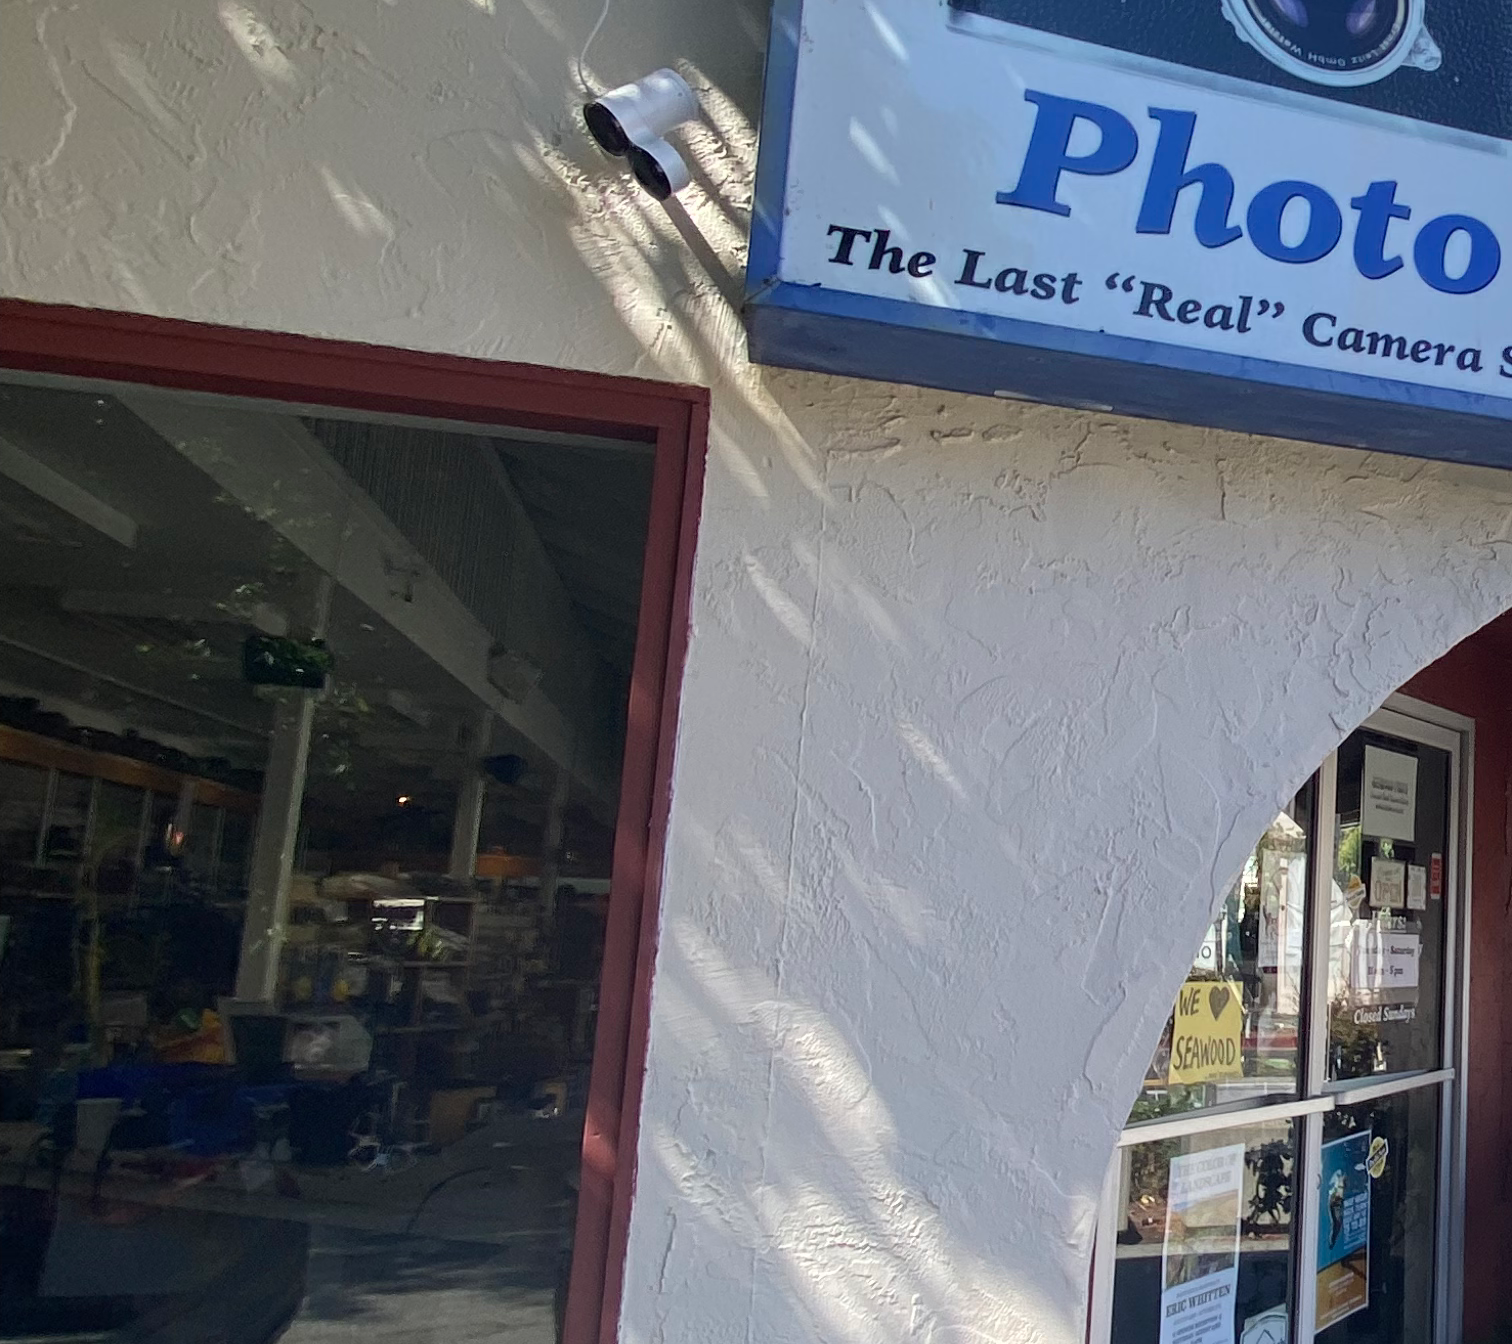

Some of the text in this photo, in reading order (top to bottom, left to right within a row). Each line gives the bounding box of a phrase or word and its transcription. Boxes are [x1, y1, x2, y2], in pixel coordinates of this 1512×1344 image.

[996, 88, 1501, 295] Photo
[825, 223, 936, 279] The
[955, 248, 1083, 305] Last
[1105, 271, 1285, 334] “Real”
[1302, 312, 1484, 374] Camera
[1179, 988, 1201, 1017] WE
[1353, 1006, 1383, 1025] Closed
[1173, 1035, 1236, 1070] SEAWOOD
[1166, 1298, 1187, 1318] ERIC
[1188, 1283, 1232, 1309] WHITTEN
